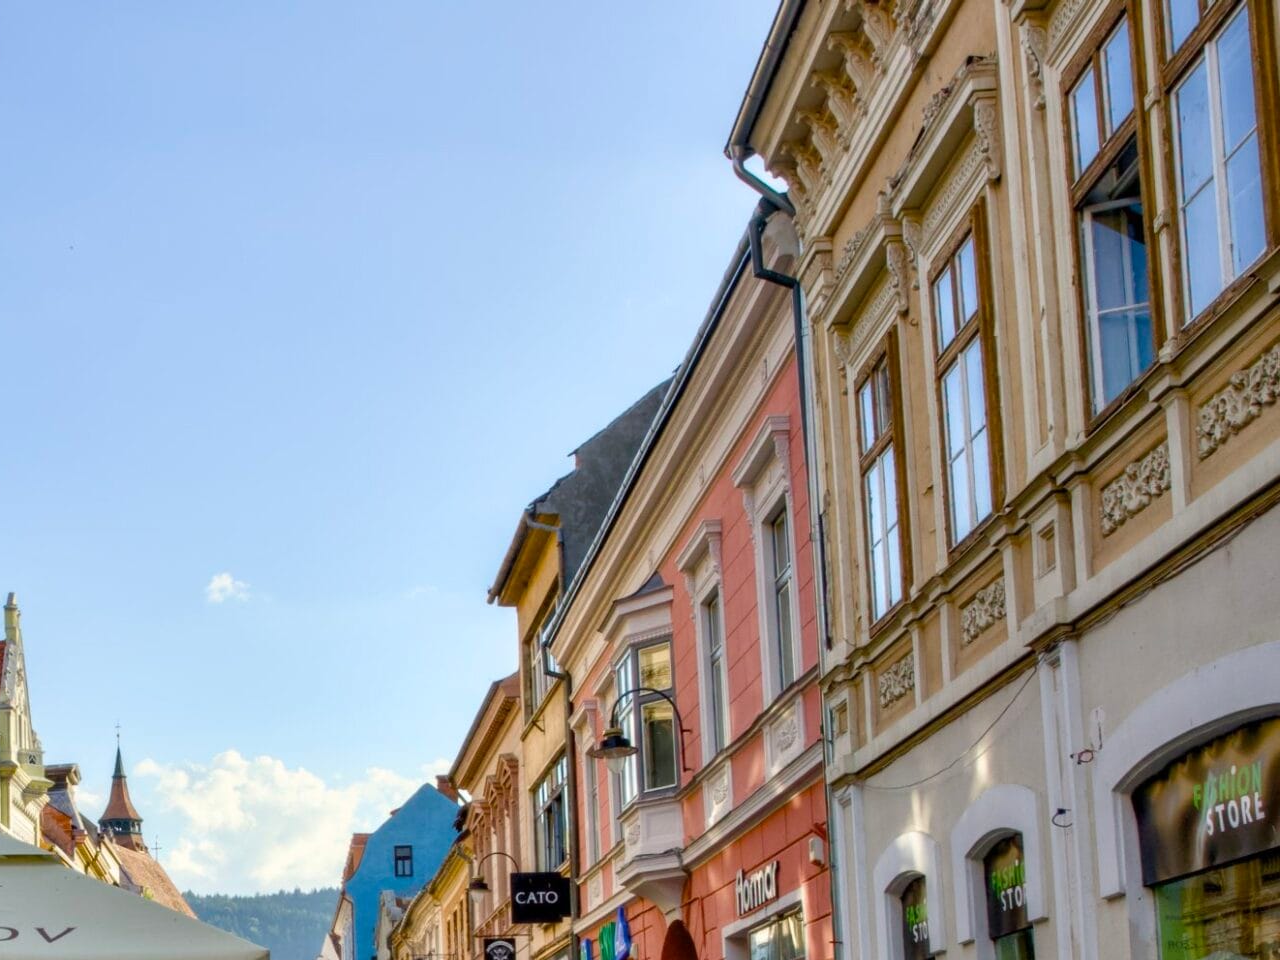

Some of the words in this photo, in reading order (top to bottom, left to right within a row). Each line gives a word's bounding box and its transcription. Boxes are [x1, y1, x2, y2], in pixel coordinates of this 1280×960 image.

[1206, 791, 1266, 836] STORE
[515, 891, 558, 904] CATO
[1000, 883, 1027, 912] STO
[912, 923, 929, 943] STO
